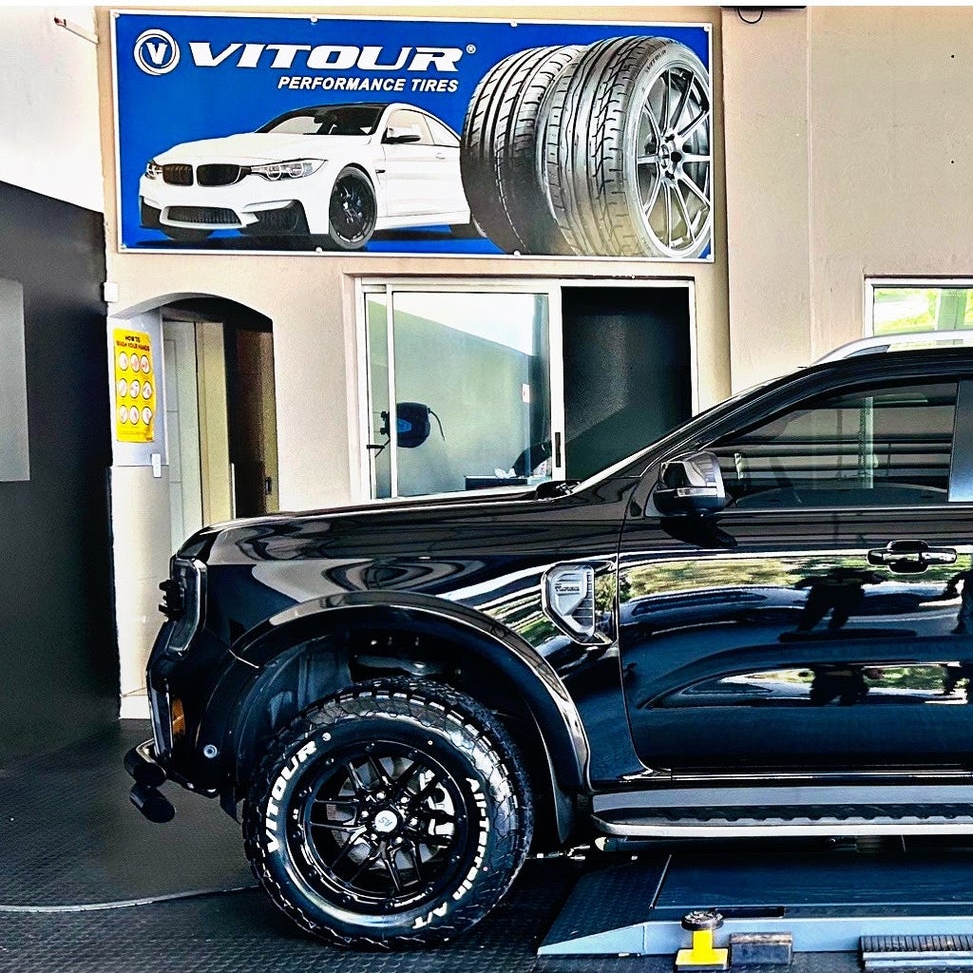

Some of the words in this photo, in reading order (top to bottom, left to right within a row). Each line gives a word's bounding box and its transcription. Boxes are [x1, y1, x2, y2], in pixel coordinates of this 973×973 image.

[188, 41, 463, 72] VITOUR
[277, 75, 405, 92] PERFORMANCE
[411, 77, 459, 93] TIRES
[265, 740, 318, 854] VITOUR
[452, 777, 491, 901] All-Terrain
[412, 902, 449, 929] A/T
